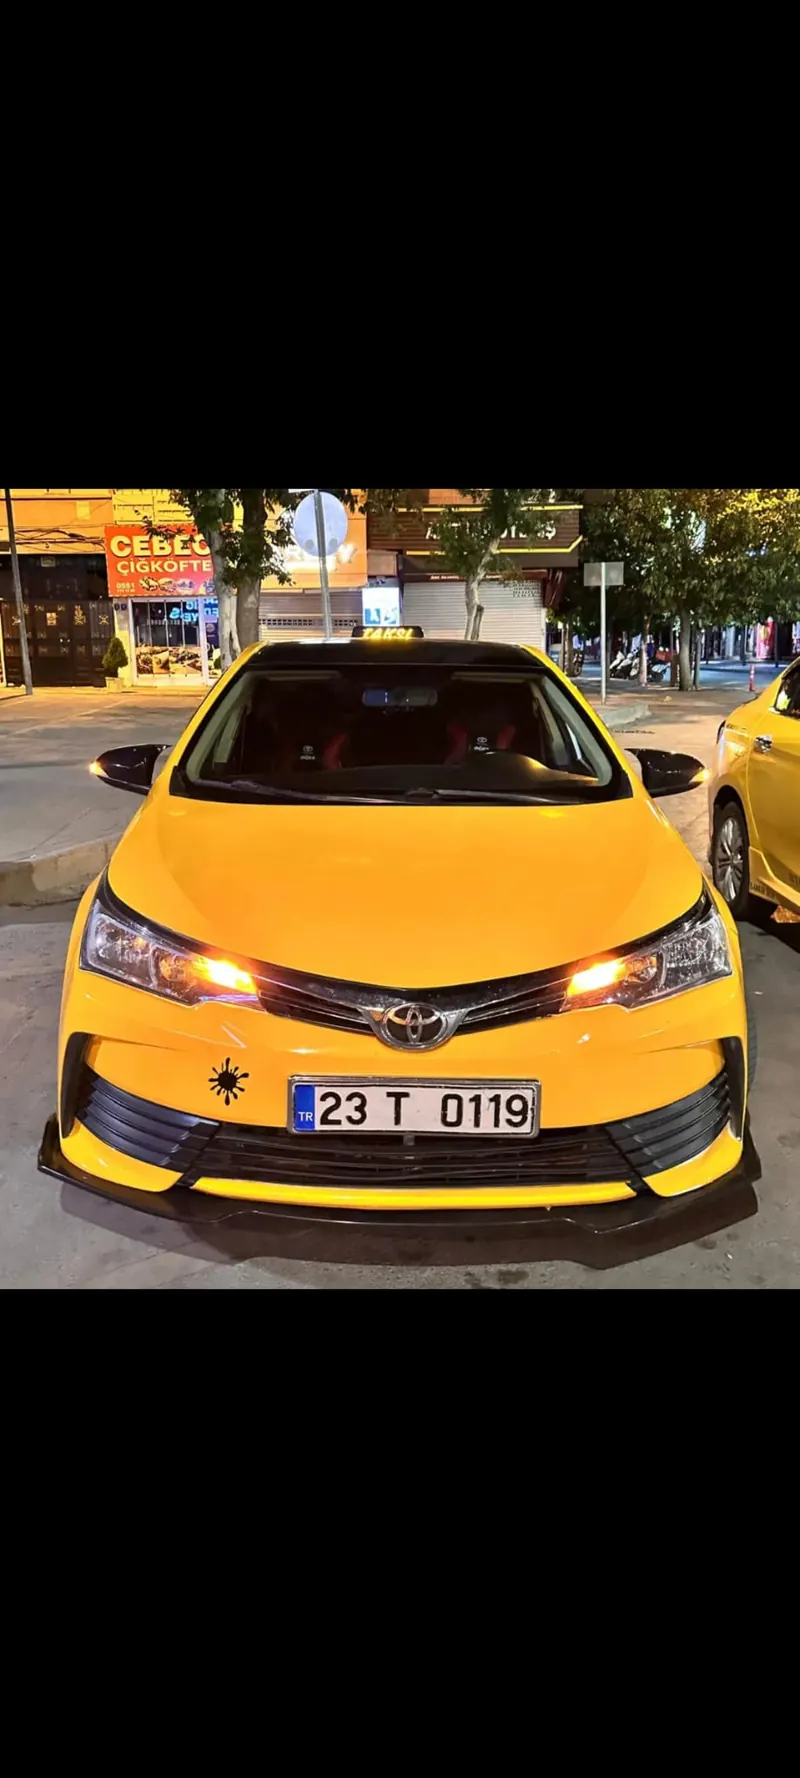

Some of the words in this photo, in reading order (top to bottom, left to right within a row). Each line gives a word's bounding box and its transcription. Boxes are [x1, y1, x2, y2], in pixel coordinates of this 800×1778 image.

[116, 558, 213, 576] ÇİĞKÖFTE
[298, 1111, 314, 1122] TR
[319, 1091, 367, 1126] 23
[386, 1092, 410, 1126] T
[441, 1093, 529, 1128] 0119
